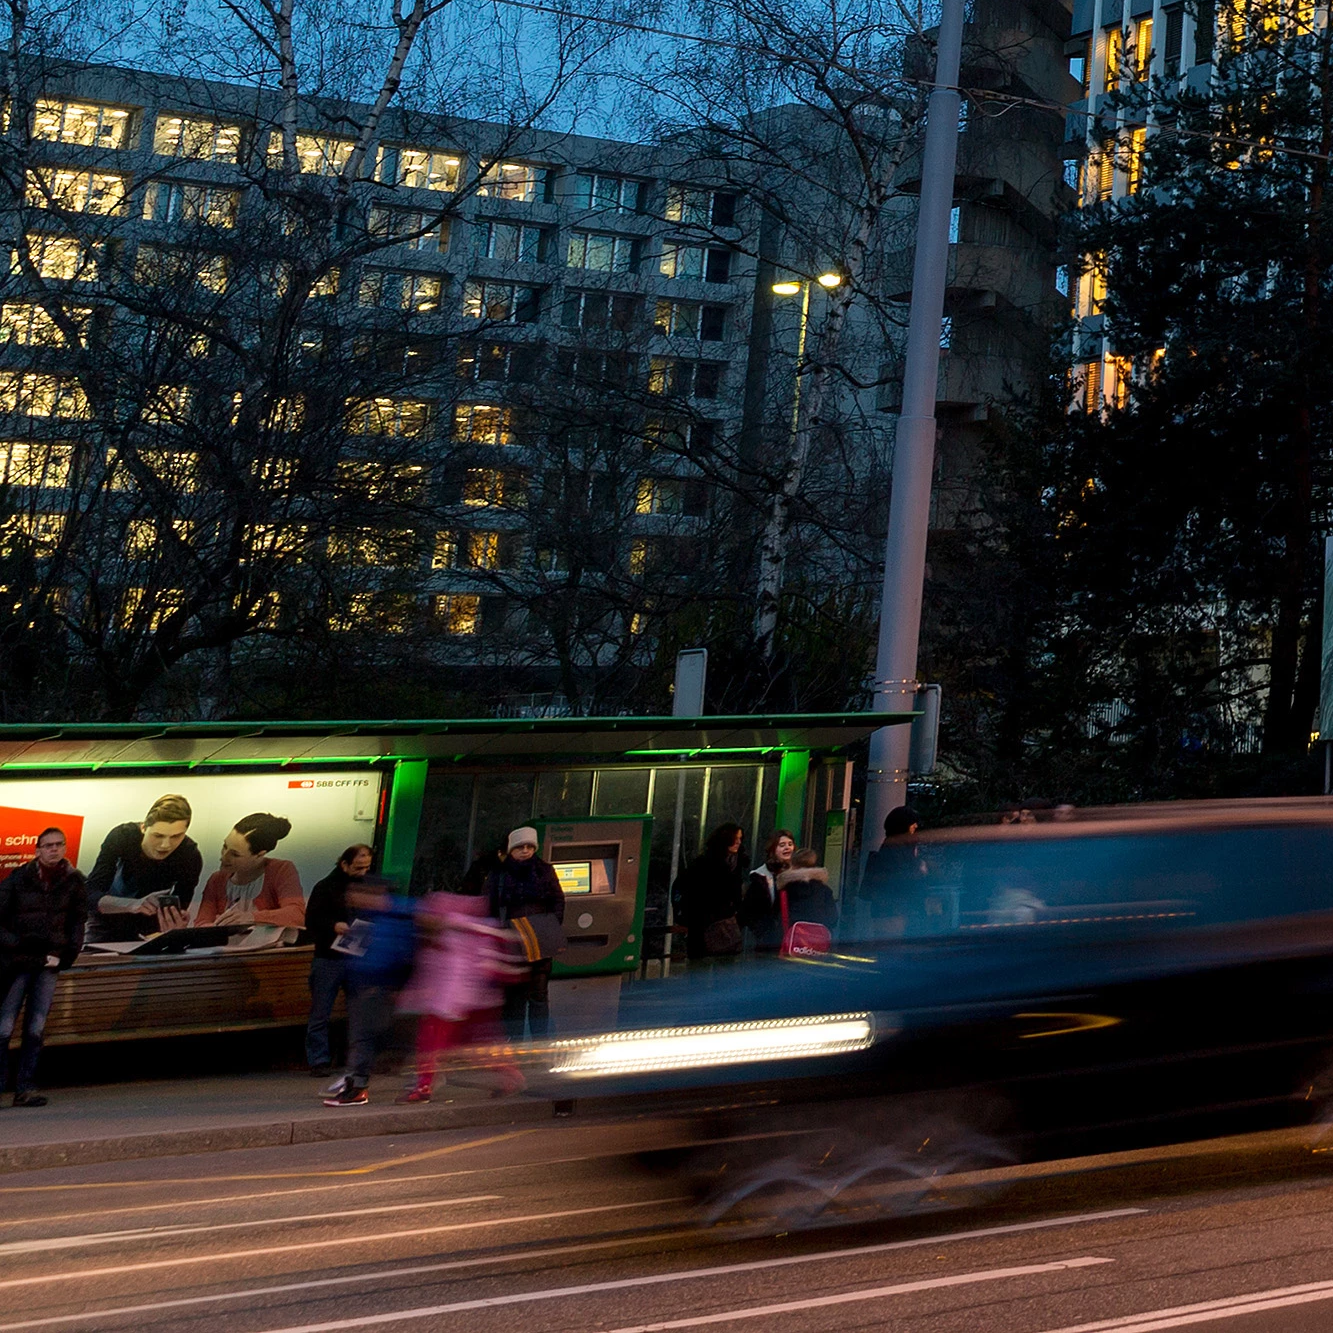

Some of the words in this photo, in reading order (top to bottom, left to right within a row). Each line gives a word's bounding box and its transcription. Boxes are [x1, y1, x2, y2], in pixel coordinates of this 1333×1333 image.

[316, 780, 334, 788] SBB
[335, 779, 352, 787] CFF
[353, 779, 369, 787] FFS
[5, 834, 39, 846] schn
[793, 946, 822, 956] adida
